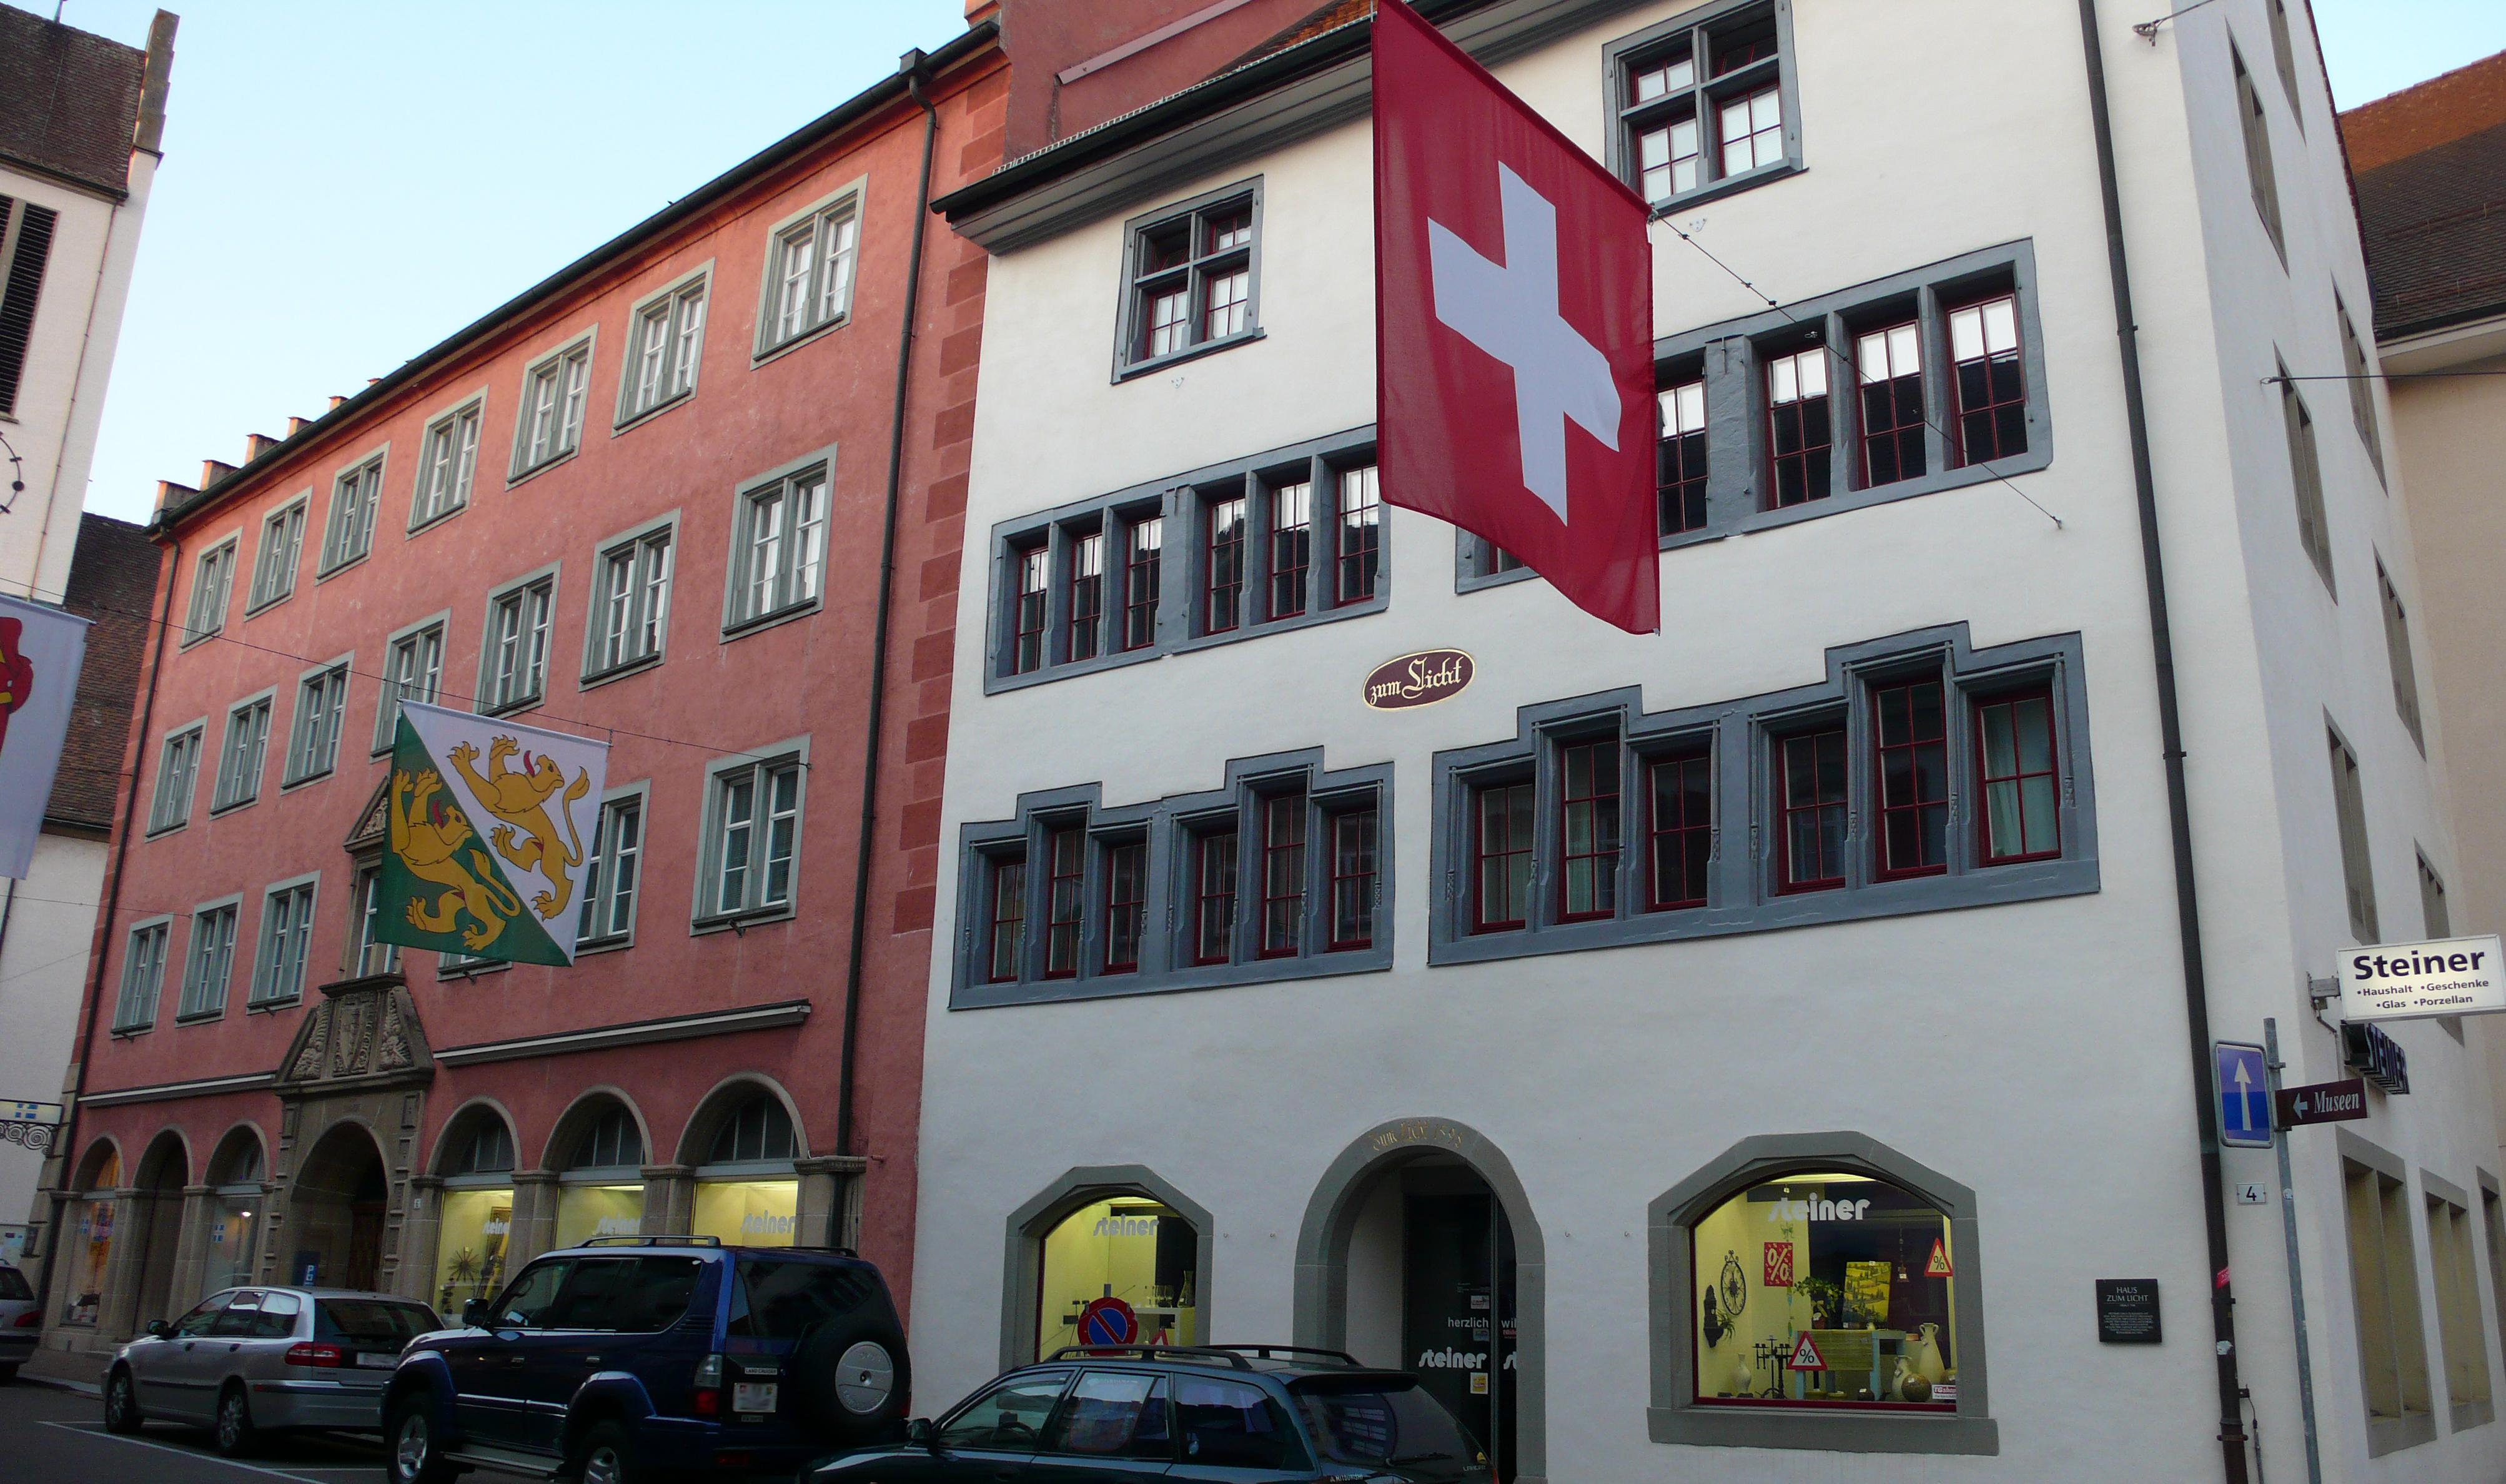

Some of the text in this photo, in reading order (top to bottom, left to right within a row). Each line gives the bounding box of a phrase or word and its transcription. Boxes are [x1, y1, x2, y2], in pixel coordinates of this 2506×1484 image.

[1370, 656, 1464, 705] zum Licht
[2353, 950, 2485, 980] Steiner
[2363, 979, 2489, 996] Haushalt Geschenke
[2382, 995, 2473, 1009] Glas Porzellan
[2314, 1091, 2359, 1114] Museen
[2246, 1186, 2256, 1201] 4
[1768, 1192, 1870, 1220] steiner
[1093, 1214, 1159, 1236] steiner
[1448, 1317, 1488, 1328] herzlich
[1419, 1347, 1487, 1368] steiner
